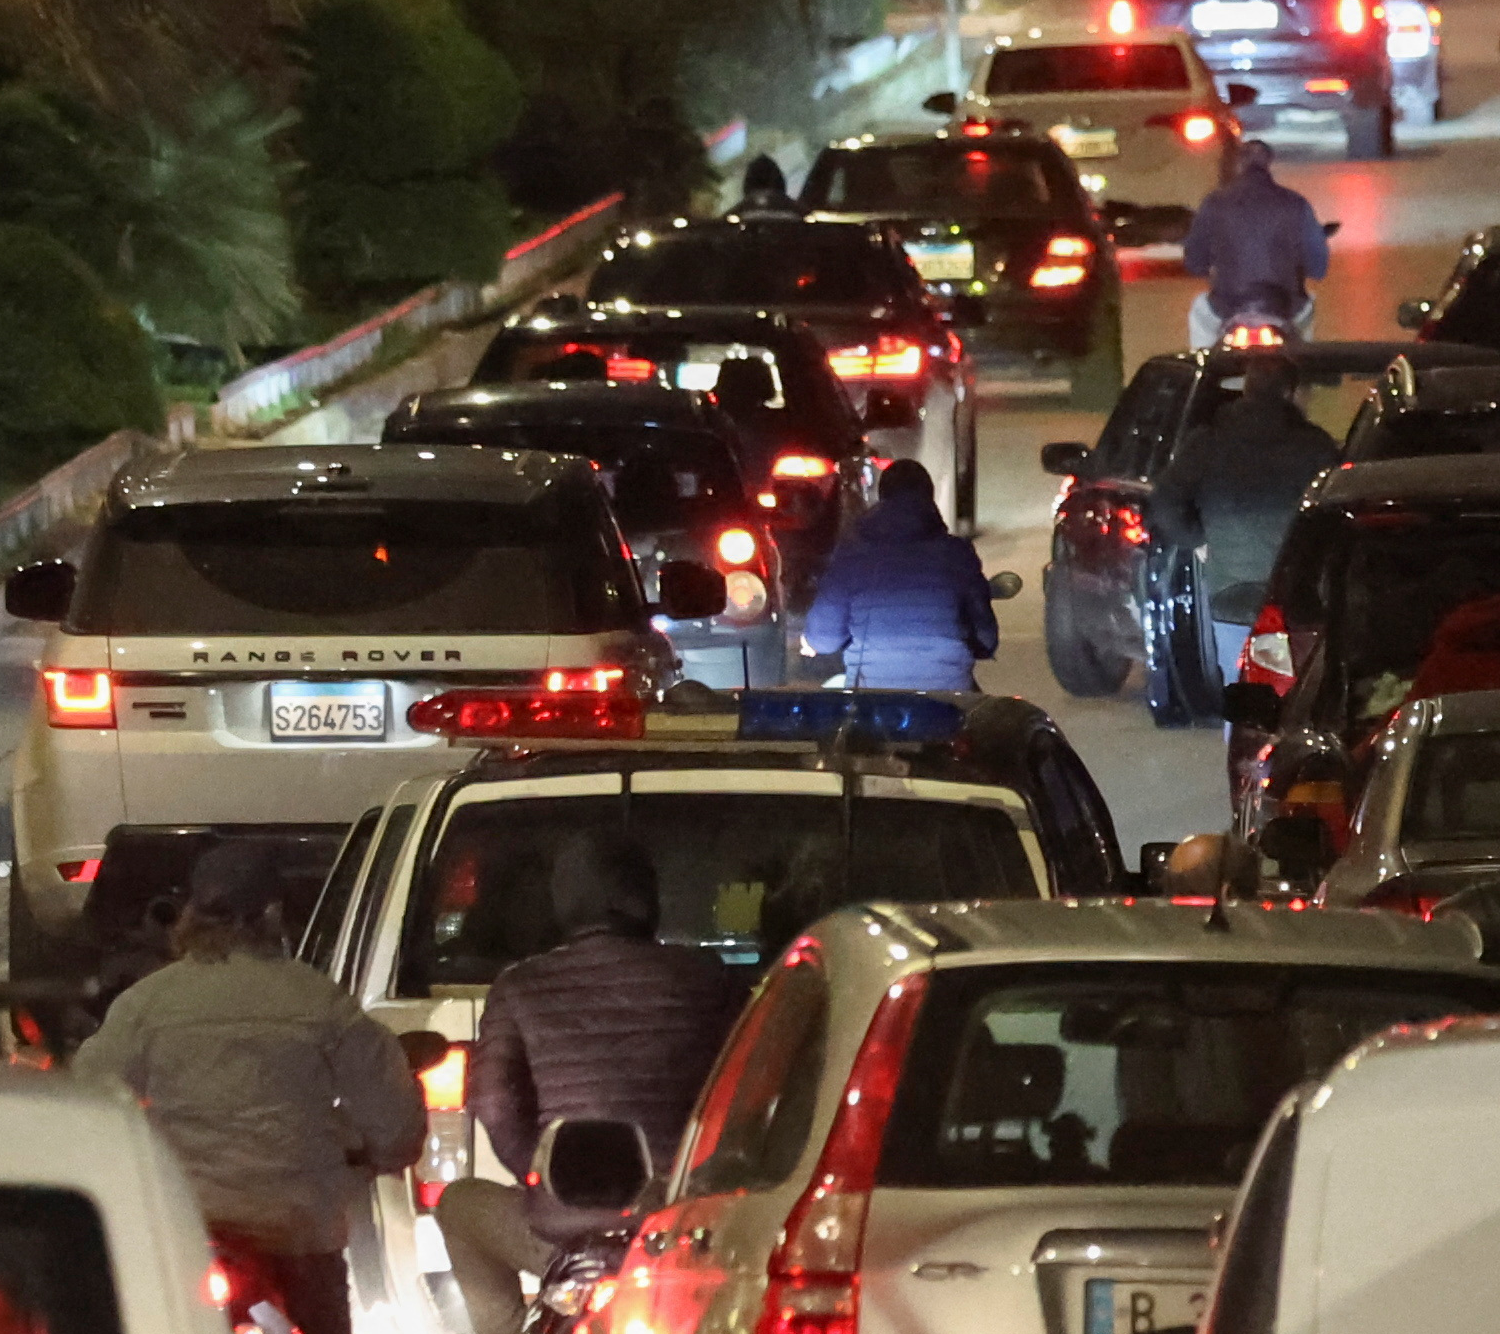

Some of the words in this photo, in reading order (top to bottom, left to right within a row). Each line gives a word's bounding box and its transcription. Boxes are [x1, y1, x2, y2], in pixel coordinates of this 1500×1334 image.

[193, 650, 316, 663] RANGE
[341, 649, 462, 662] ROVER
[274, 704, 383, 732] S264753
